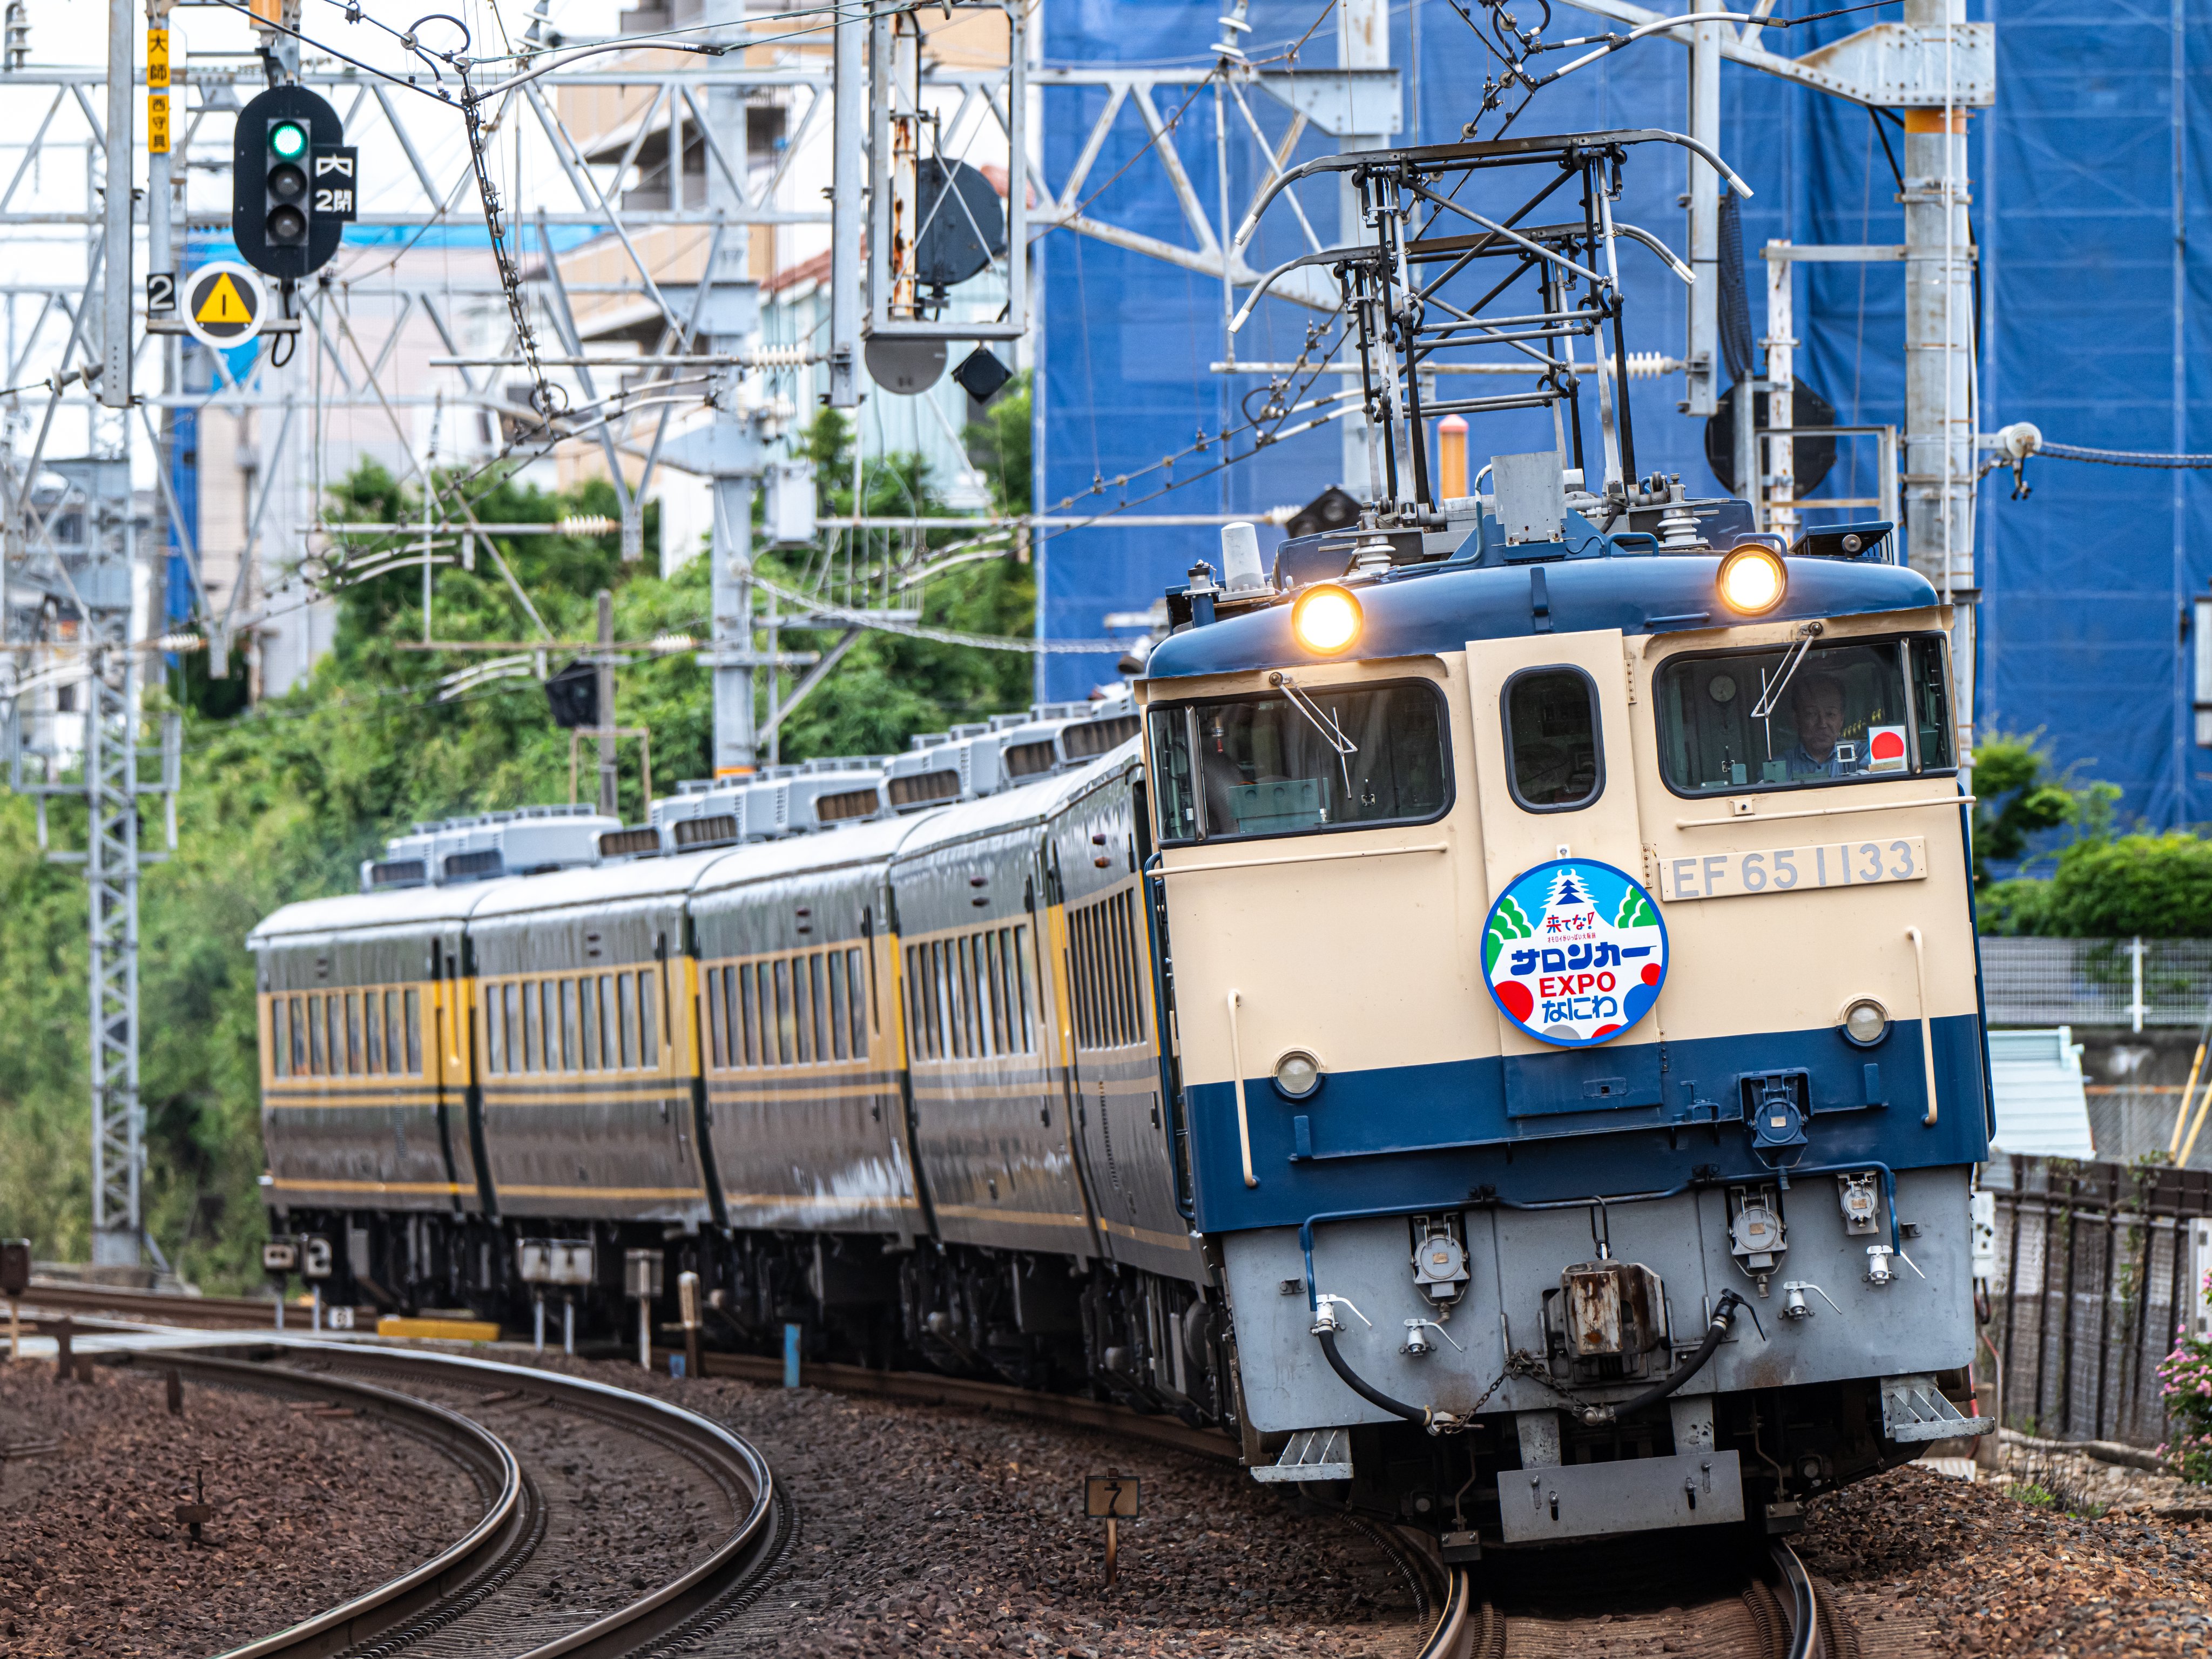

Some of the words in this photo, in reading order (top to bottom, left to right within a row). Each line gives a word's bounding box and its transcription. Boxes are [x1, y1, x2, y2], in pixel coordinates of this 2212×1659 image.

[150, 34, 167, 81] 大師
[315, 152, 353, 178] 内
[148, 274, 174, 311] 2
[1672, 855, 1728, 899] EF
[1816, 840, 1915, 887] 1133
[1510, 941, 1657, 976] サロンカー
[1539, 971, 1616, 998] EXPO
[1541, 995, 1618, 1023] なにわ
[1104, 1486, 1122, 1515] 7
